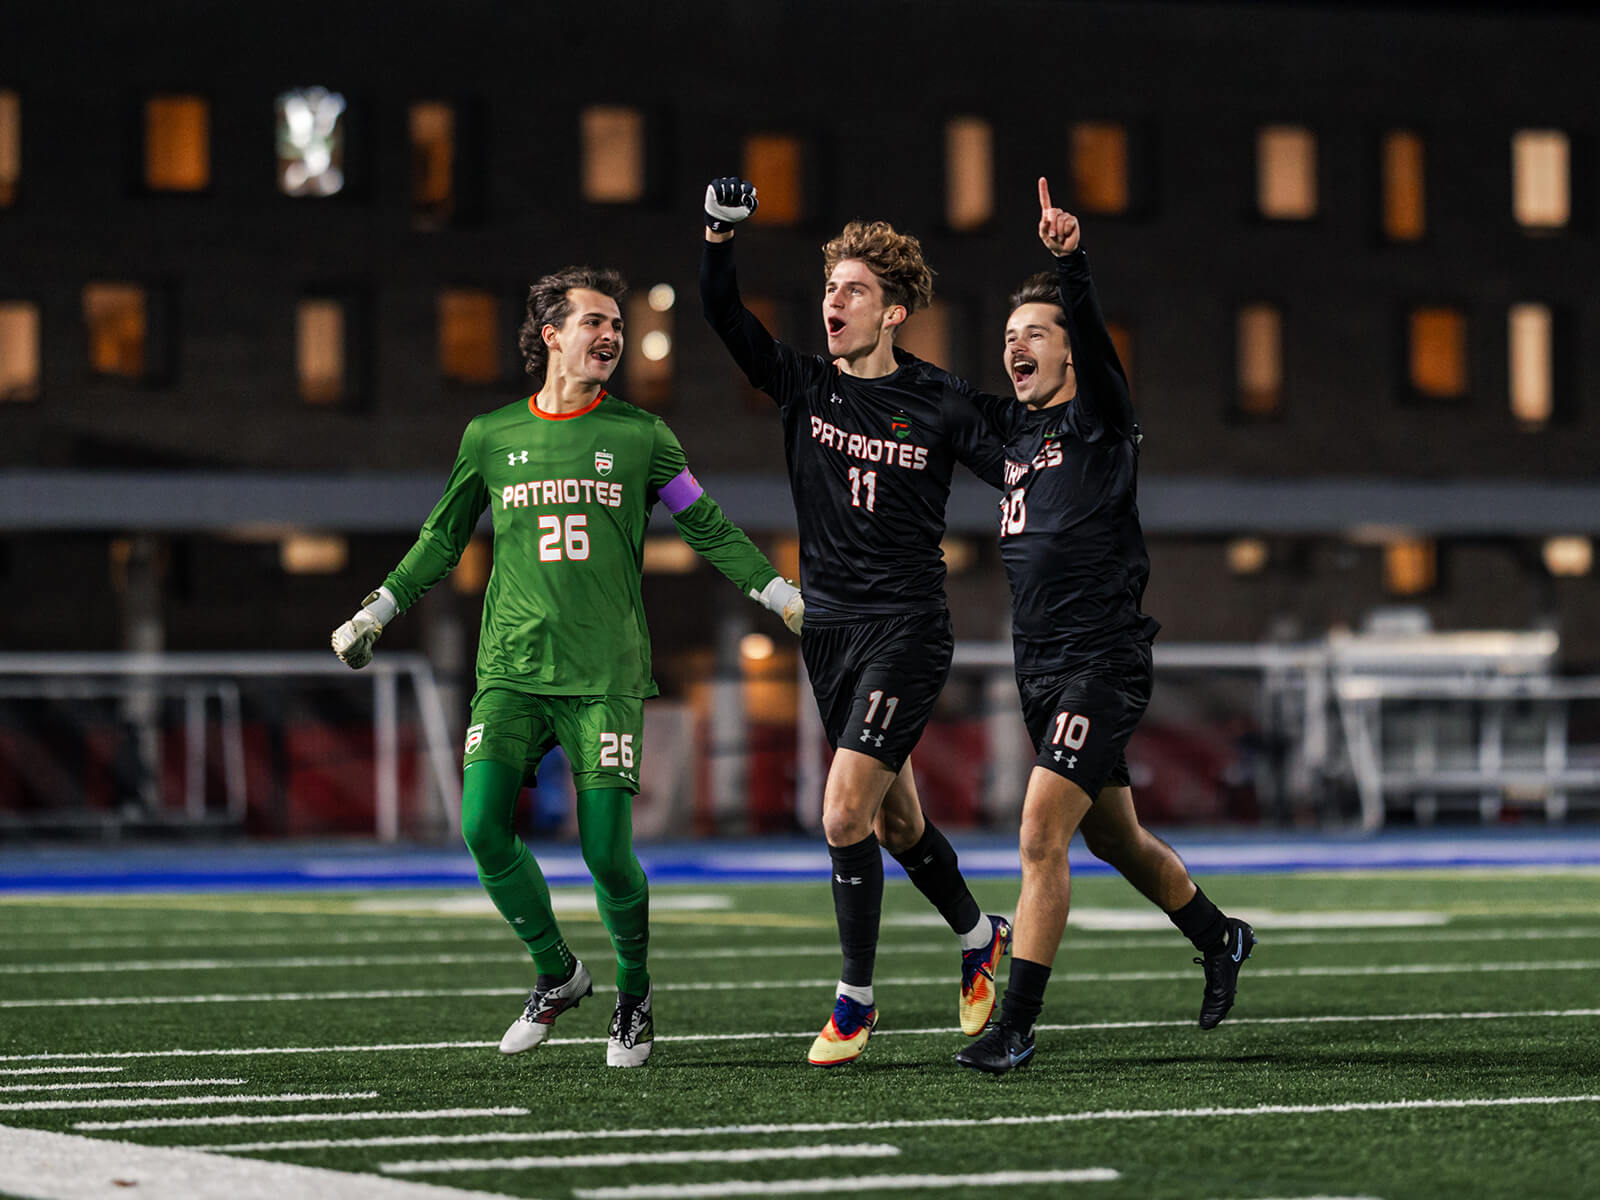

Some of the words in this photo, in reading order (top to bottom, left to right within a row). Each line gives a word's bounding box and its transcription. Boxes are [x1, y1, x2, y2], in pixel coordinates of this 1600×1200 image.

[811, 415, 928, 470] PATRIOTES
[502, 479, 622, 509] PATRIOTES
[848, 466, 877, 512] 11
[1000, 487, 1026, 537] 10
[538, 514, 590, 561] 26
[864, 690, 899, 730] 11
[1052, 712, 1089, 750] 10
[600, 732, 634, 768] 26
